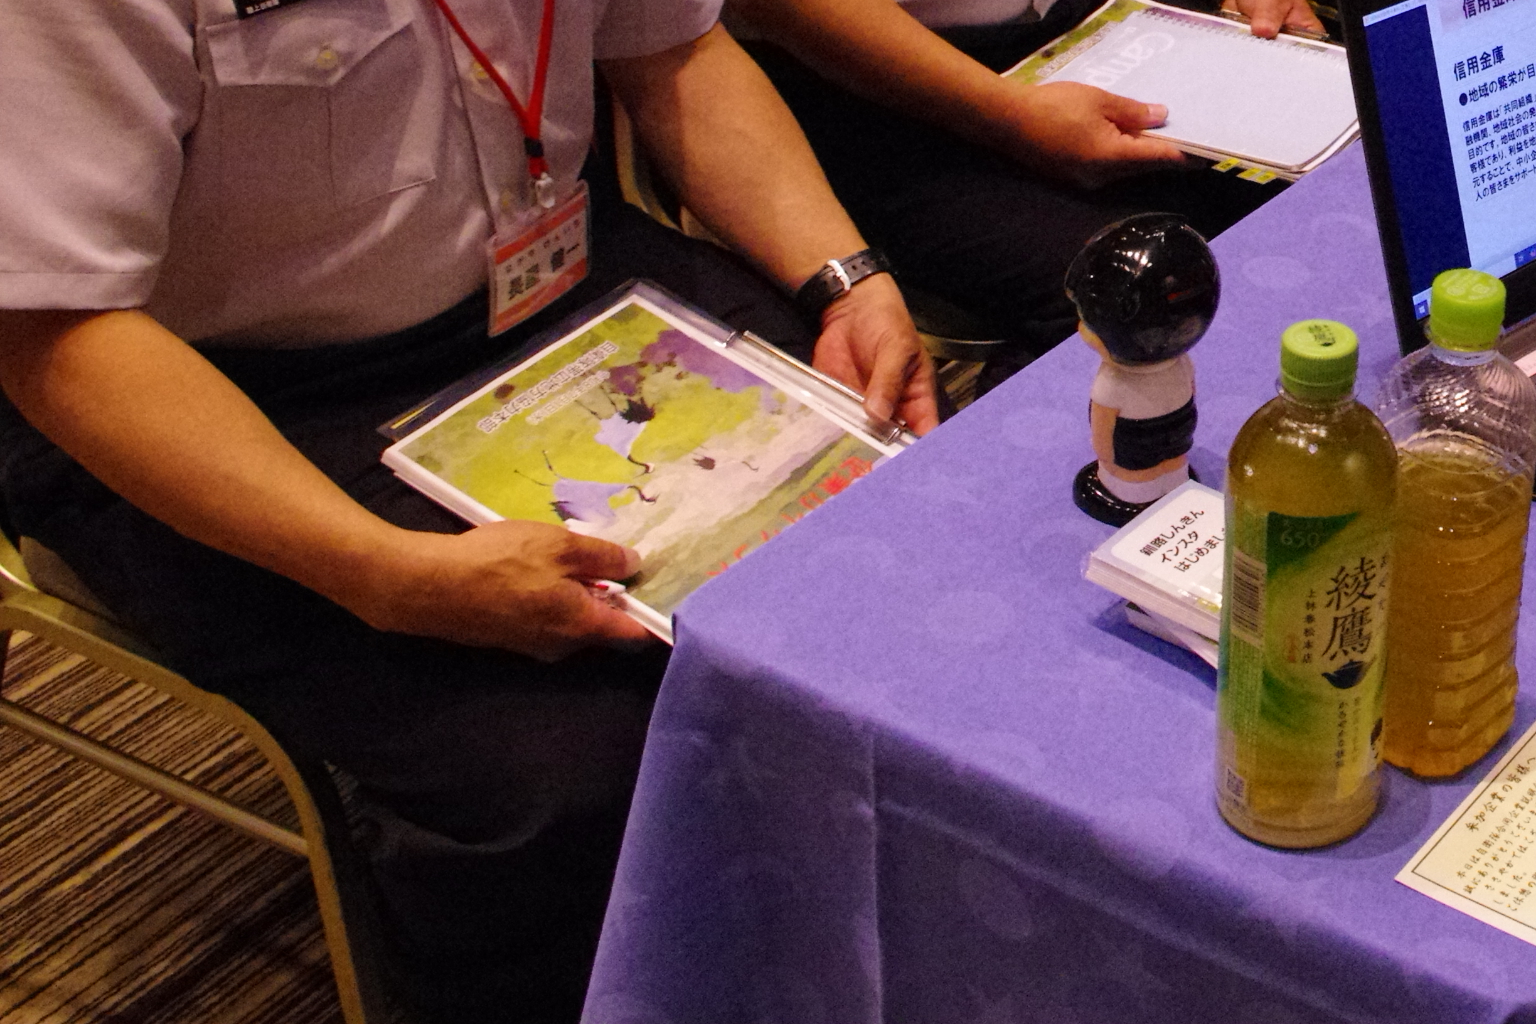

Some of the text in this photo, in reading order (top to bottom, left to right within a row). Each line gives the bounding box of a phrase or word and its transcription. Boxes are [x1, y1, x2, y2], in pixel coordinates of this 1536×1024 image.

[1453, 45, 1506, 82] 信用金庫
[1160, 530, 1199, 564] インスタ
[1174, 528, 1226, 573] はじめまし
[1321, 556, 1377, 661] 綾鷹
[1465, 756, 1536, 832] 参加企業の皆様へ
